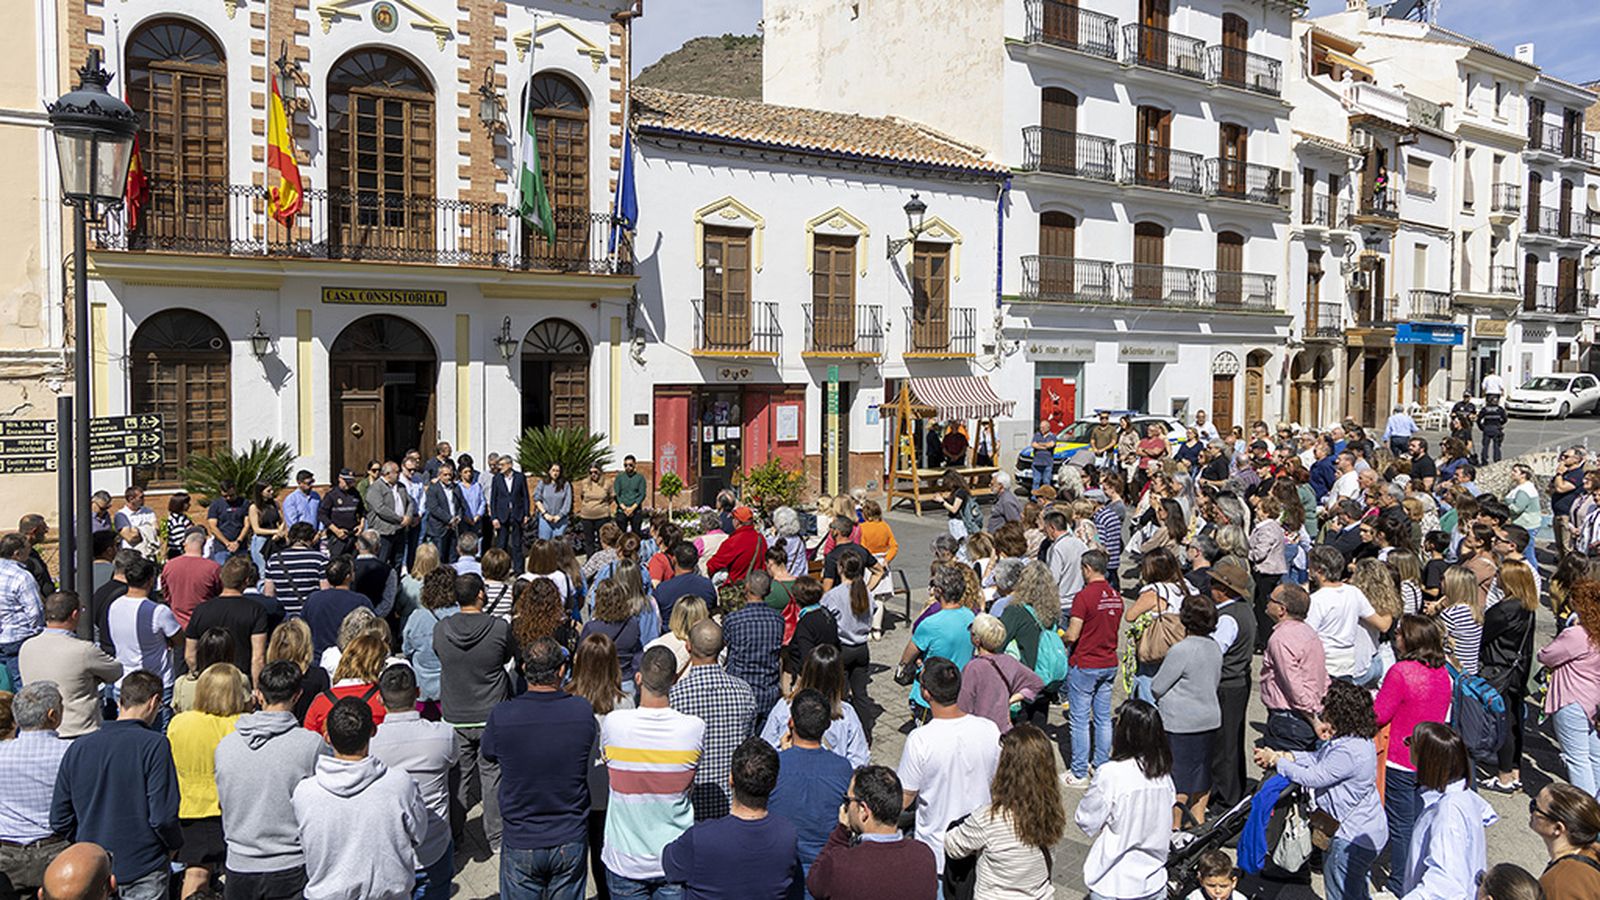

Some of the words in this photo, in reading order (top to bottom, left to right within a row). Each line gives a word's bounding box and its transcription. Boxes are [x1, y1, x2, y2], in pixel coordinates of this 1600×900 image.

[327, 290, 356, 302] CASA
[360, 291, 443, 304] CONSISTORIAL
[6, 445, 45, 453] municipal
